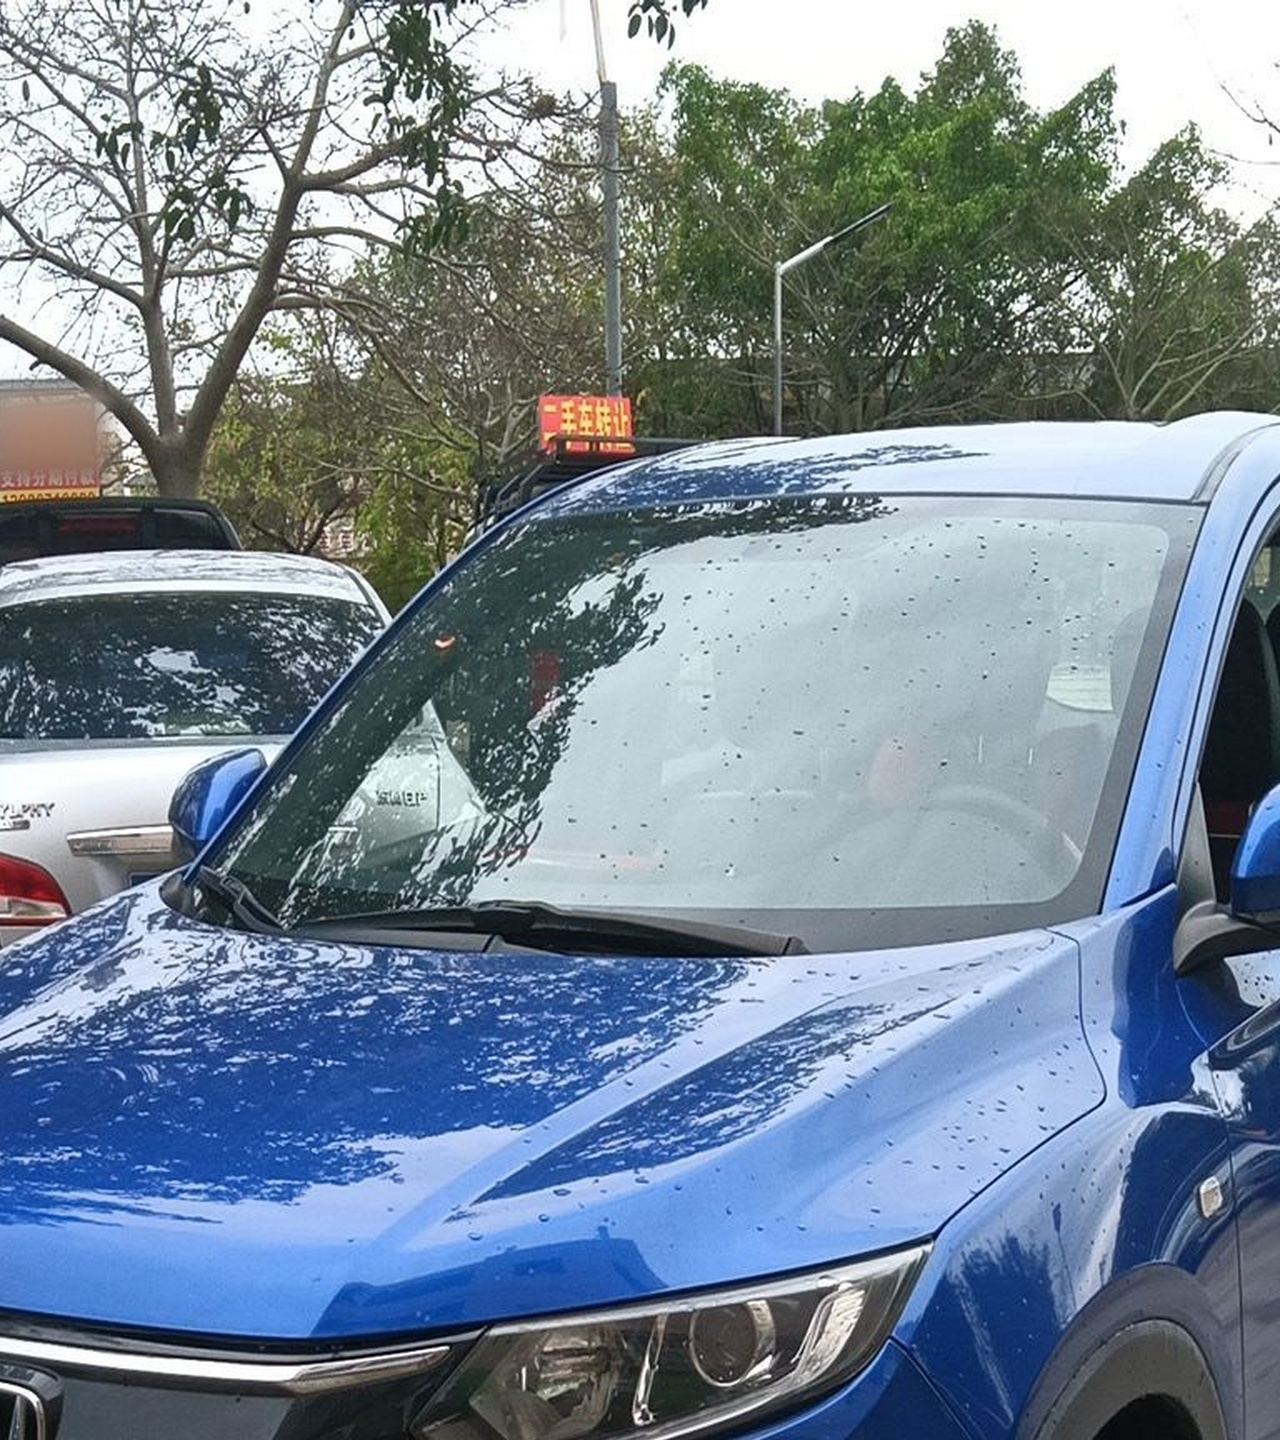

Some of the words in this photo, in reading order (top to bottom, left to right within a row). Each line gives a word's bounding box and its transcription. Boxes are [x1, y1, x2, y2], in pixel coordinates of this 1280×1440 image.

[543, 400, 630, 438] 二手车转让
